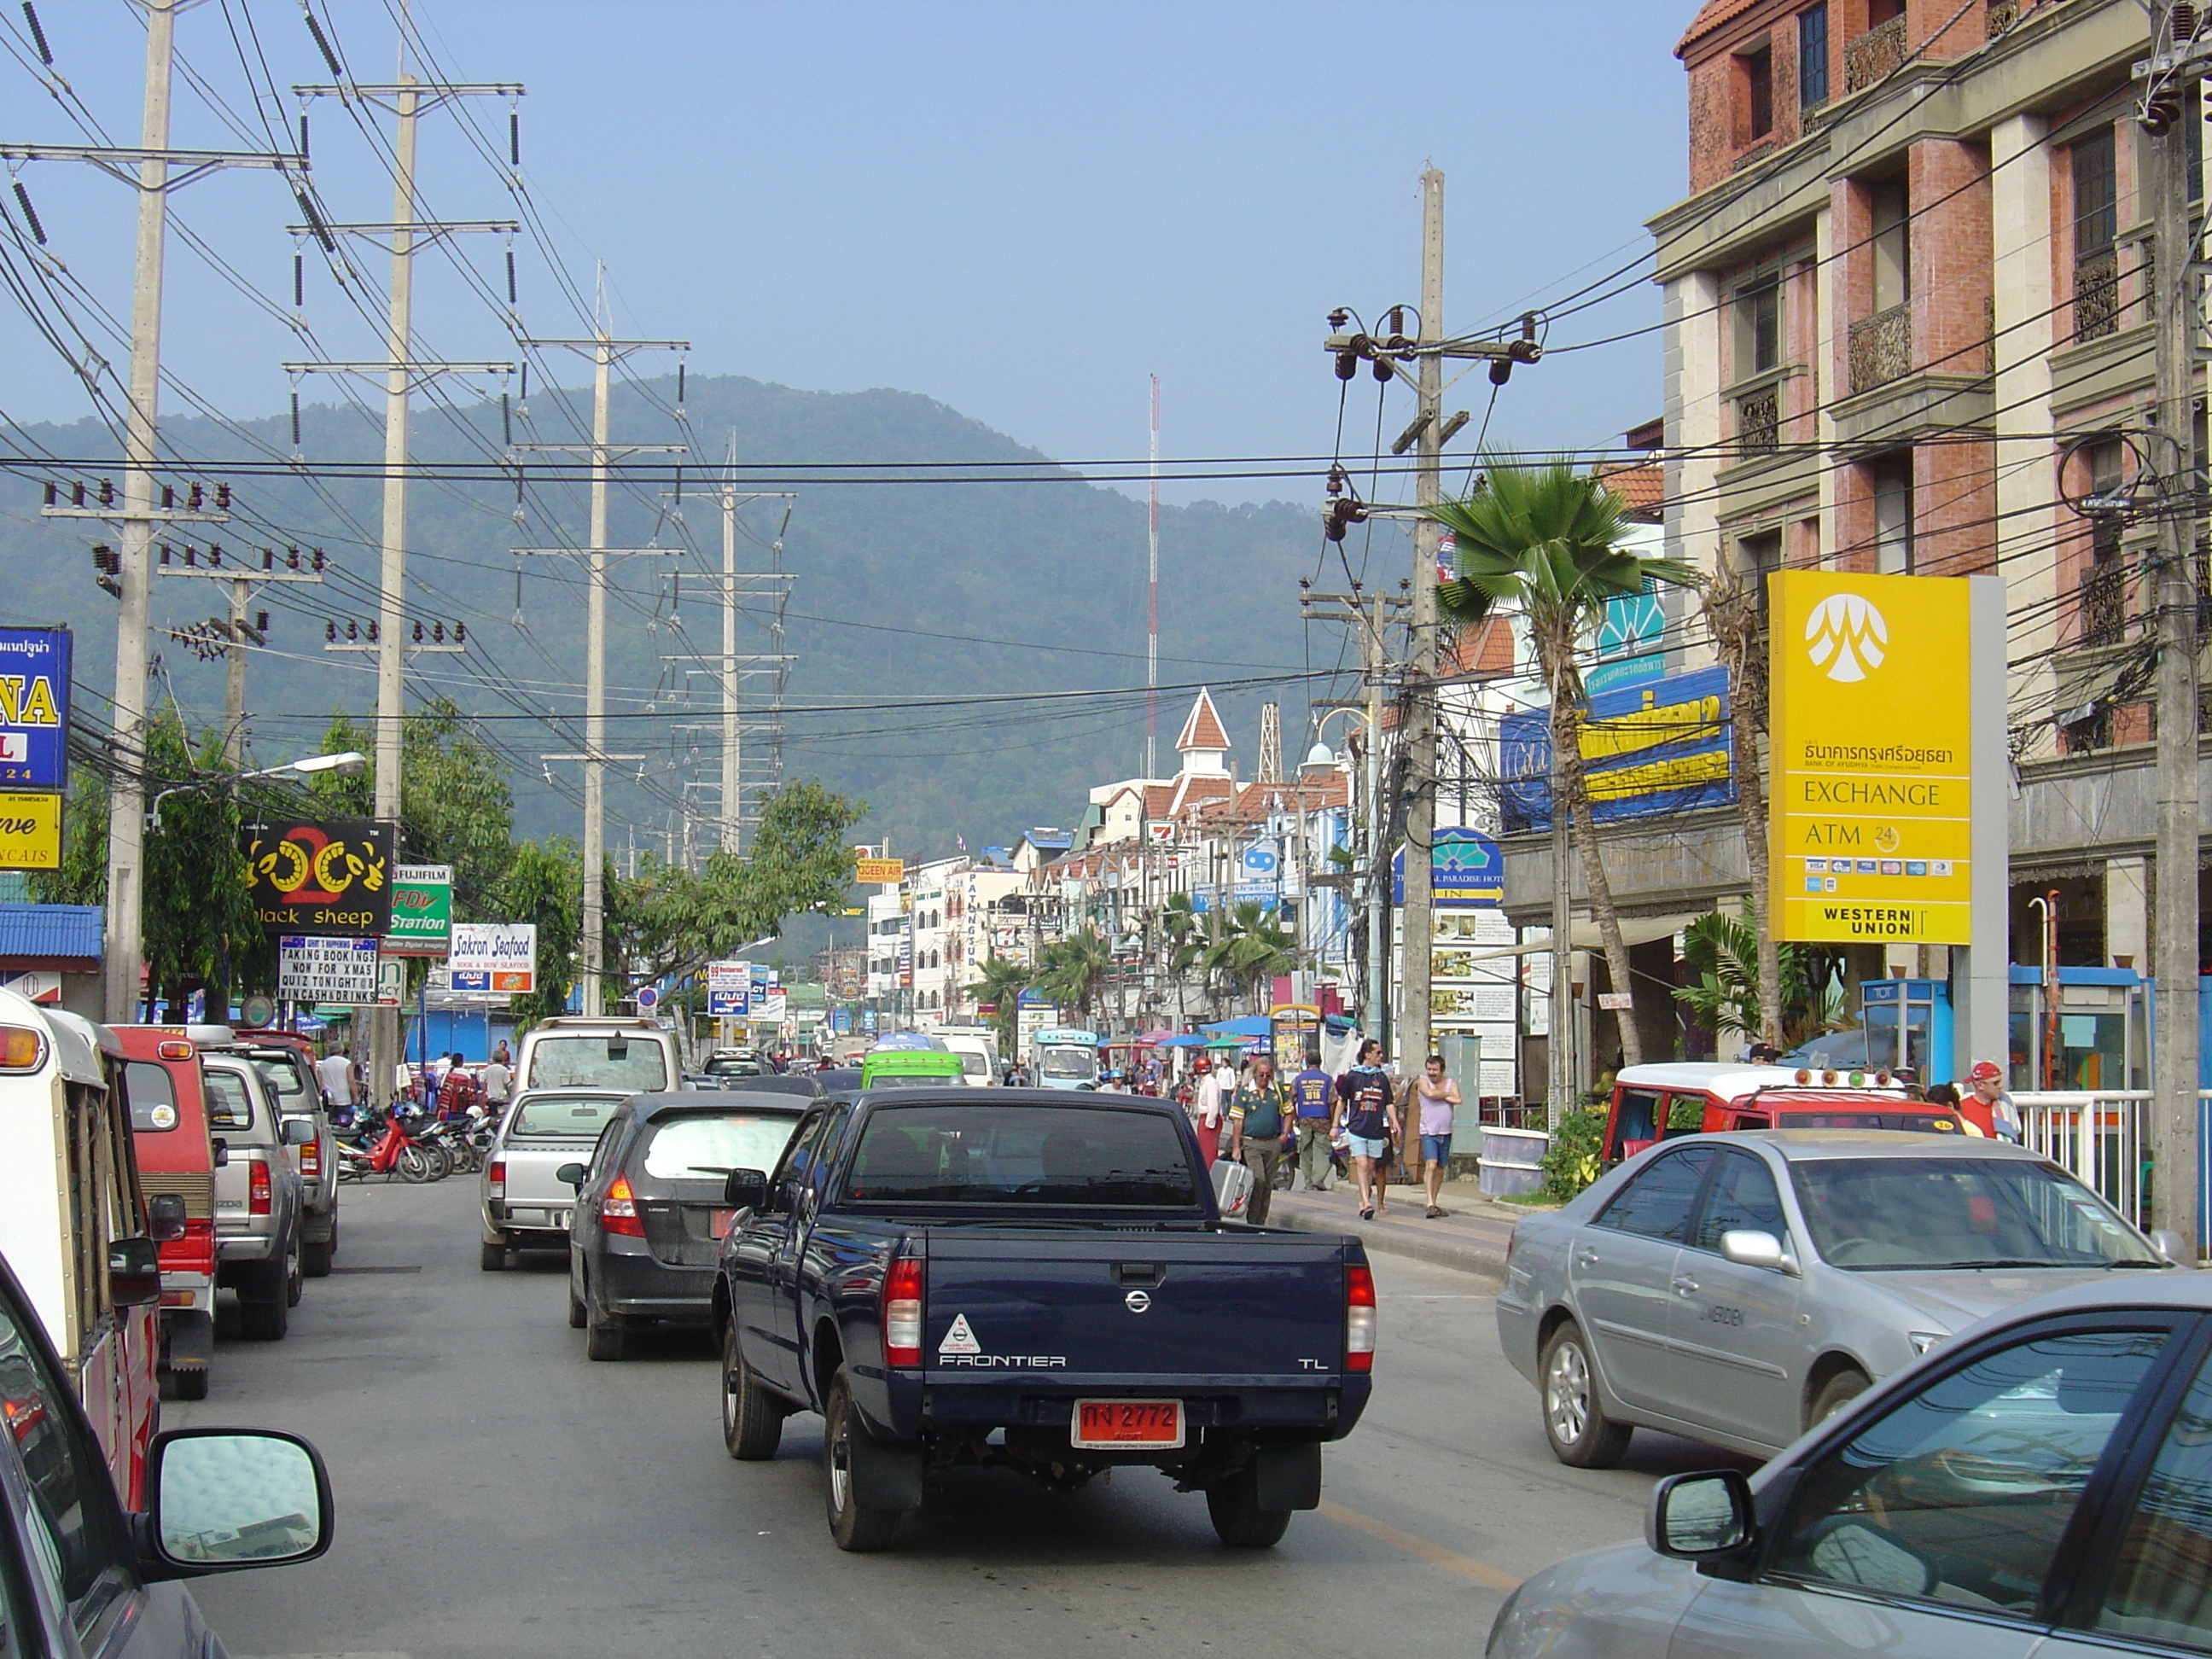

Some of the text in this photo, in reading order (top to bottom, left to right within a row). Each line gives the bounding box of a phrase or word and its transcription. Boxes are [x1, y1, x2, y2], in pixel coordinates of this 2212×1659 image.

[1805, 744, 1953, 765] ธนาคารกรุงศรีอยุธยา
[1805, 781, 1940, 806] EXCHANGE
[1805, 824, 1893, 844] ATM 24
[399, 870, 446, 880] FUJIFILM
[859, 865, 901, 876] QUEEN AIR
[313, 909, 374, 928] sheep
[1824, 908, 1911, 921] WESTERN
[1851, 922, 1911, 934] UNION
[454, 934, 530, 960] Sakron Seafood
[282, 948, 375, 962] TAKING BOOKINGS
[293, 963, 311, 974] NOW
[318, 964, 336, 974] FOR
[282, 975, 308, 987] QUIZ
[312, 977, 358, 988] TONIGHT
[301, 989, 327, 1000] CASH
[336, 991, 375, 1002] DRINKS
[1873, 987, 1893, 998] TOT
[940, 1355, 1066, 1367] FRONTIER
[1297, 1359, 1329, 1370] TL
[1121, 1405, 1173, 1427] 2772
